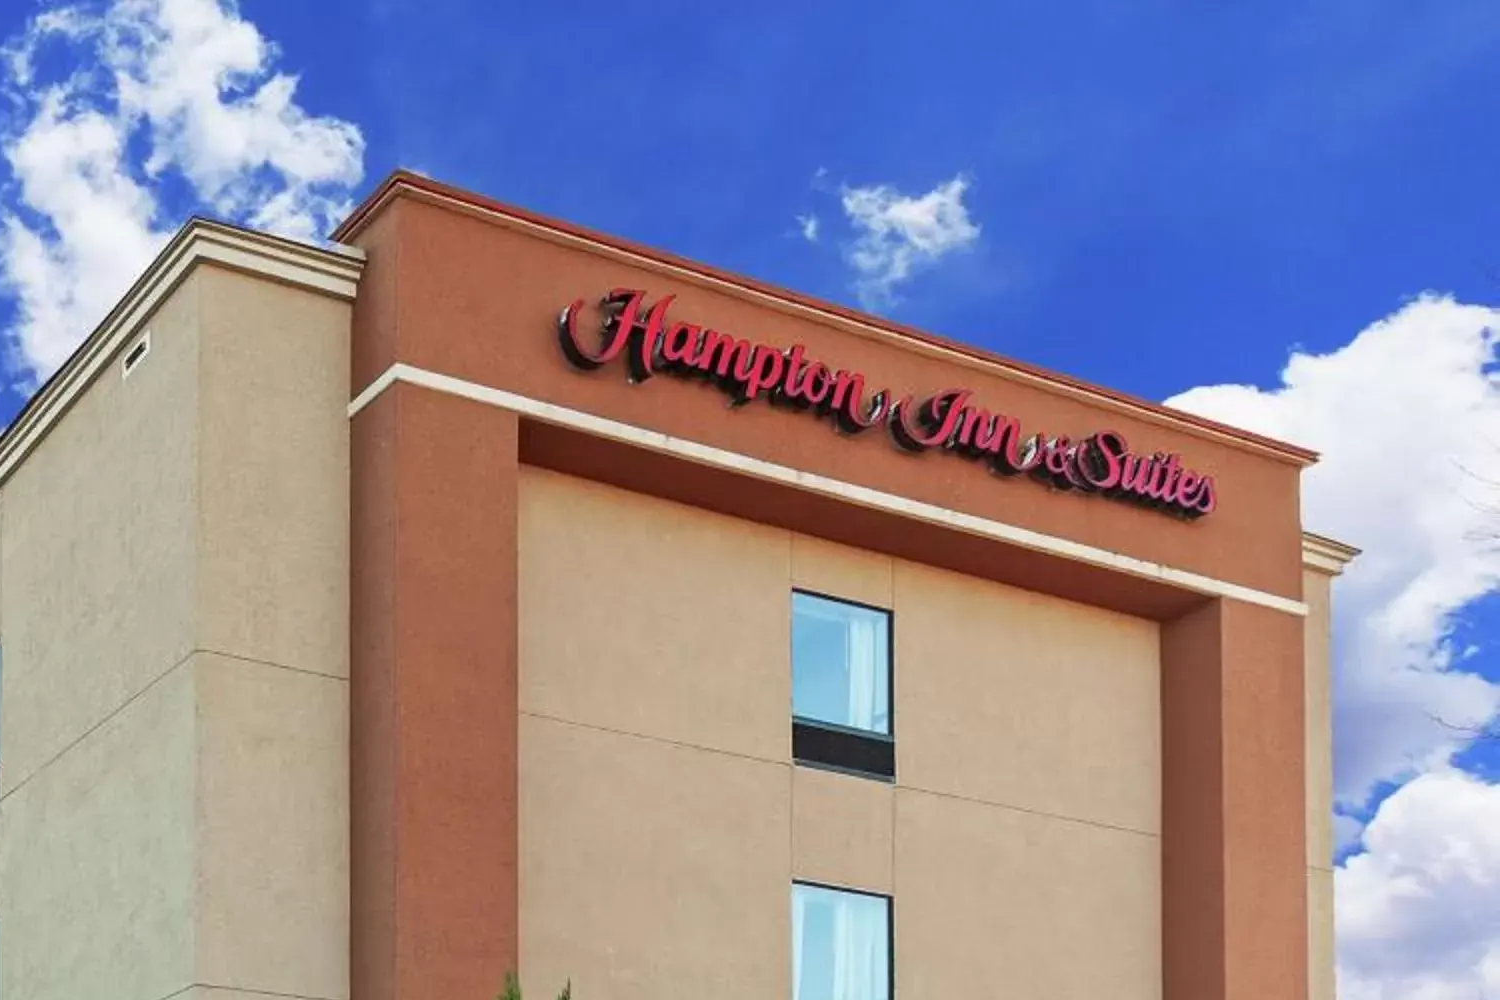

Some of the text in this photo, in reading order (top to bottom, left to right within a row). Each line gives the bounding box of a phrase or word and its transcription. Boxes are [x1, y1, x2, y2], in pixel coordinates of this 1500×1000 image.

[560, 287, 893, 432] Hampton
[892, 388, 1045, 472] Inn
[1076, 428, 1217, 514] Suites
